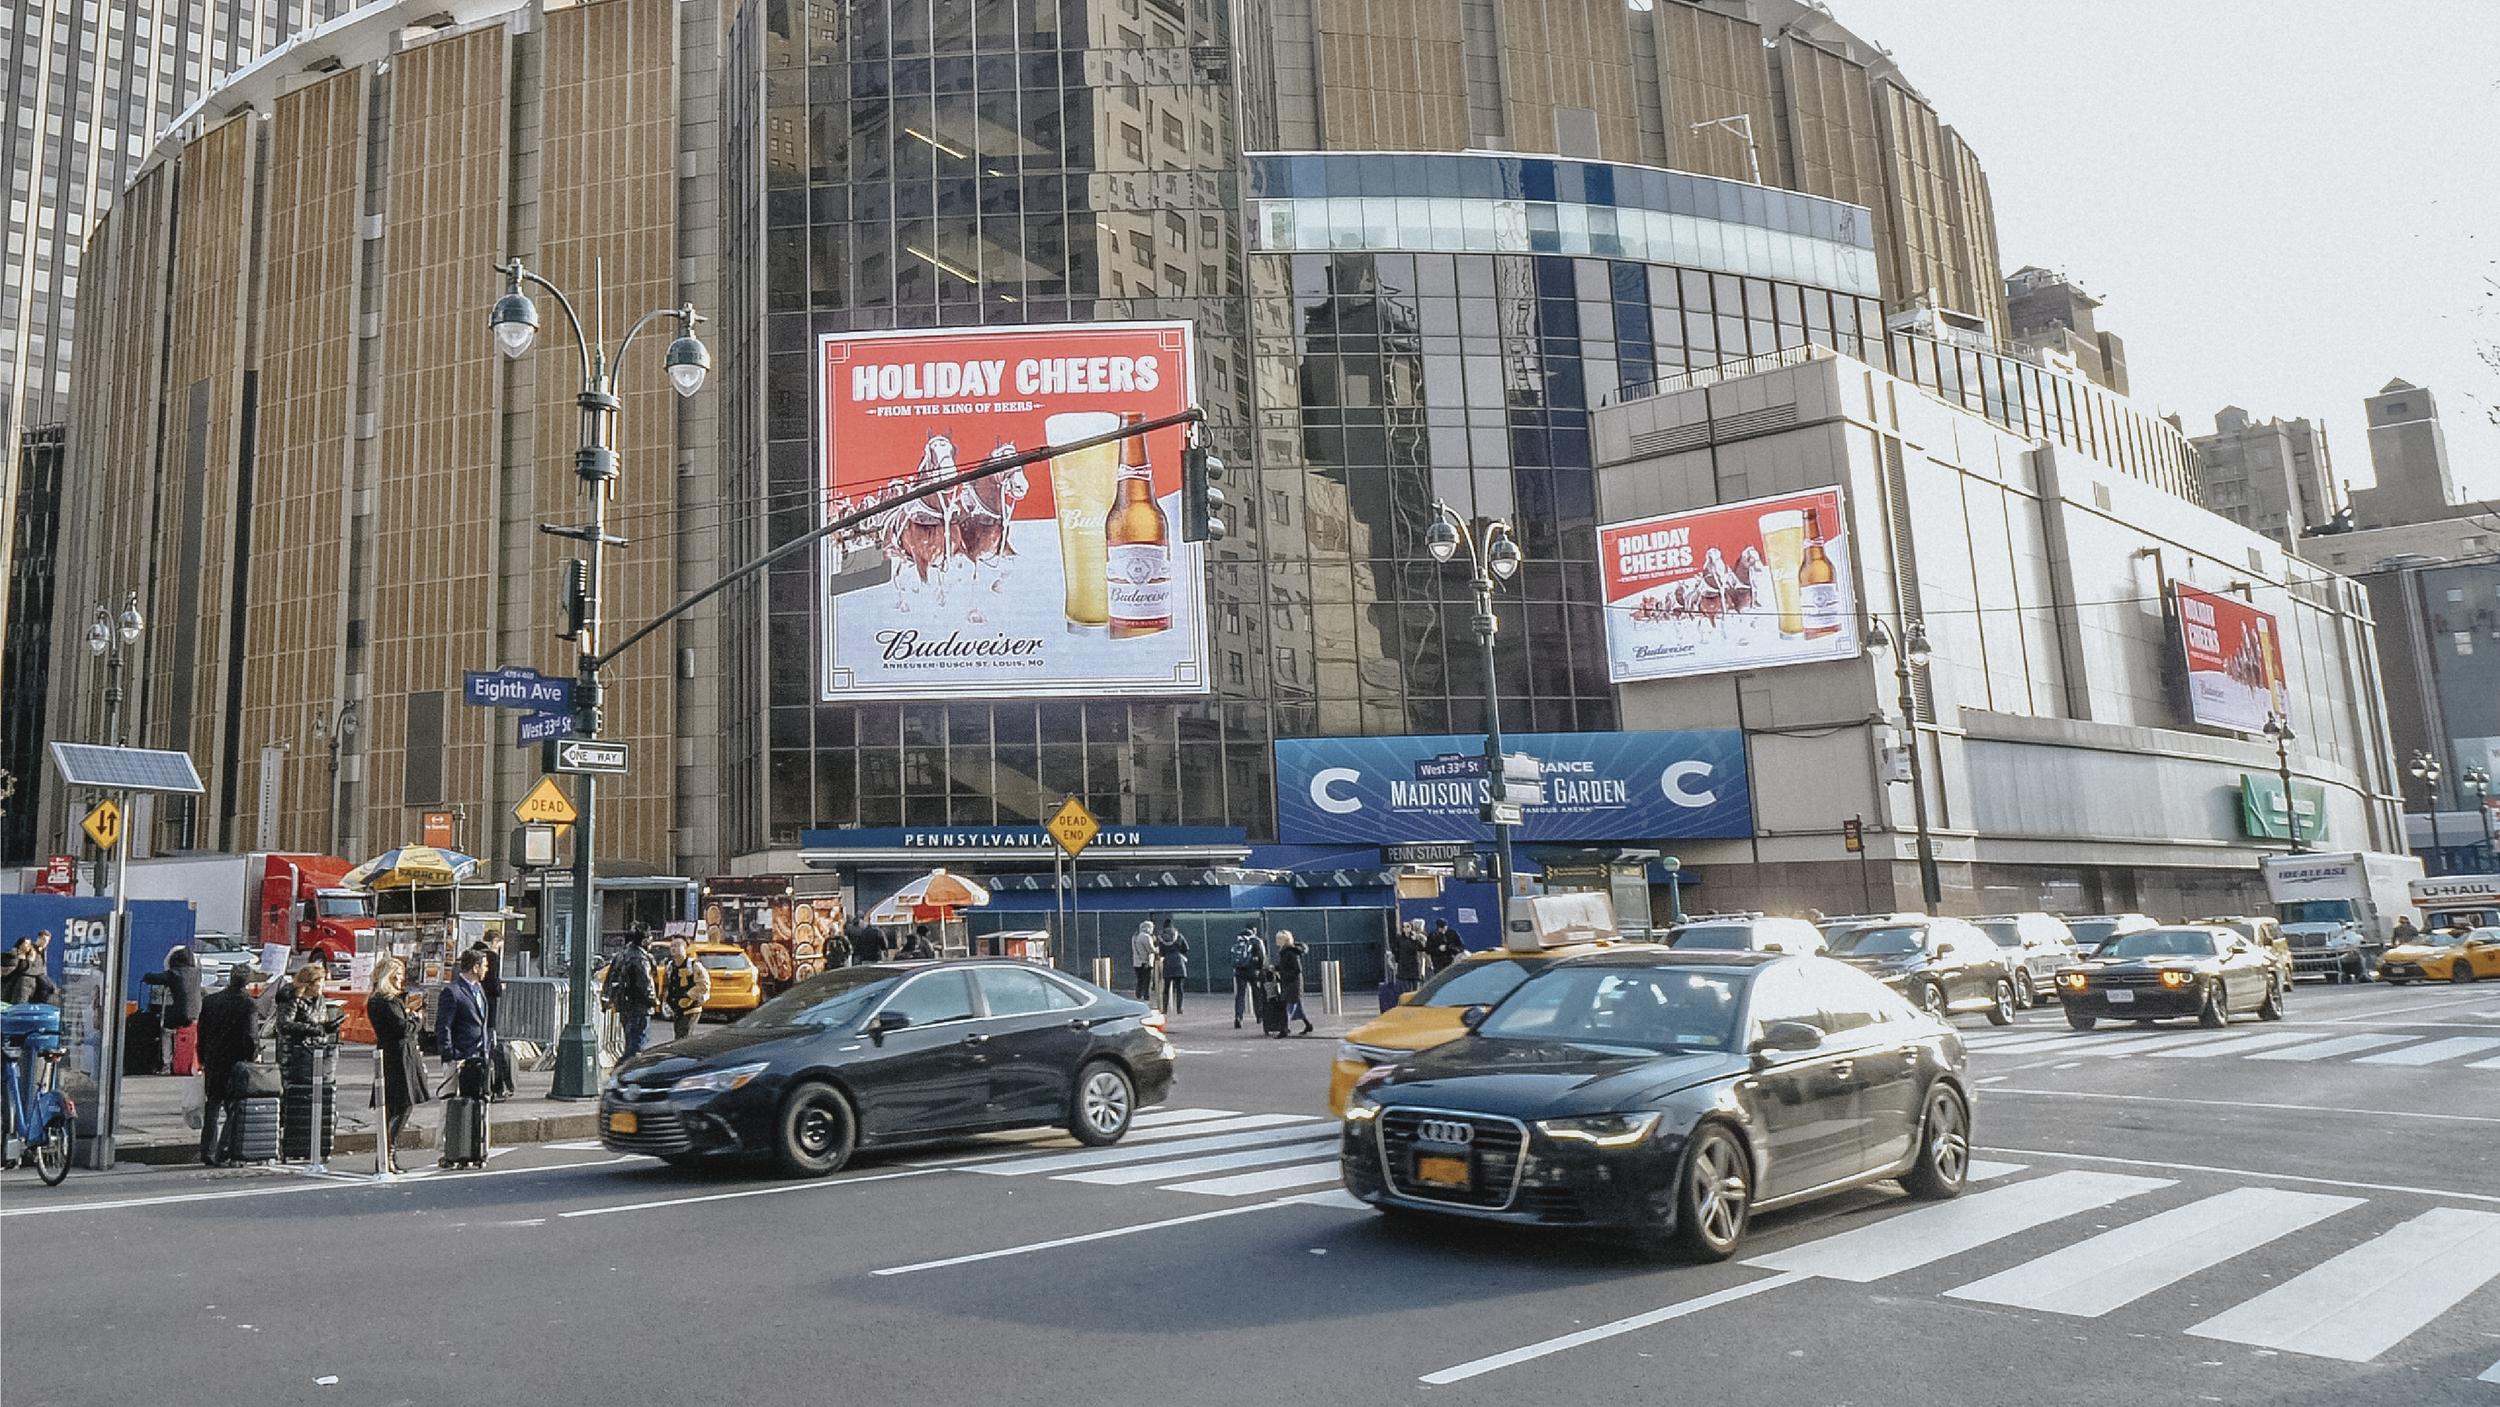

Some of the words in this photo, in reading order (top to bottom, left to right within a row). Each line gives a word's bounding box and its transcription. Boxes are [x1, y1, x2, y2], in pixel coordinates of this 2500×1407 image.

[852, 359, 1005, 401] HOLIDAY
[1016, 356, 1159, 395] CHEERS
[877, 406, 912, 417] FROM
[914, 404, 940, 416] THE
[942, 403, 973, 415] KING
[975, 402, 991, 413] OF
[994, 401, 1034, 412] BEERS
[1618, 527, 1690, 556] HOLIDAY
[1620, 546, 1693, 575] CHEERS
[875, 630, 1043, 661] Budweiser
[1028, 659, 1044, 667] MO
[475, 678, 527, 702] Eighth
[531, 683, 562, 702] Ave
[521, 722, 543, 739] West
[562, 716, 571, 733] St
[569, 750, 588, 761] ONE
[597, 752, 618, 763] WAY
[1420, 764, 1446, 776] West
[1468, 761, 1479, 773] St
[1540, 761, 1595, 773] RANCE
[1390, 780, 1473, 807] MADISON
[1554, 777, 1626, 804] GARDEN
[532, 799, 564, 813] DEAD
[1059, 815, 1087, 826] DEAD
[905, 832, 1052, 847] PENNSYLVANIA
[1089, 832, 1141, 845] TION
[1063, 829, 1084, 841] END
[1387, 847, 1414, 861] PENN
[1416, 844, 1461, 861] STATION
